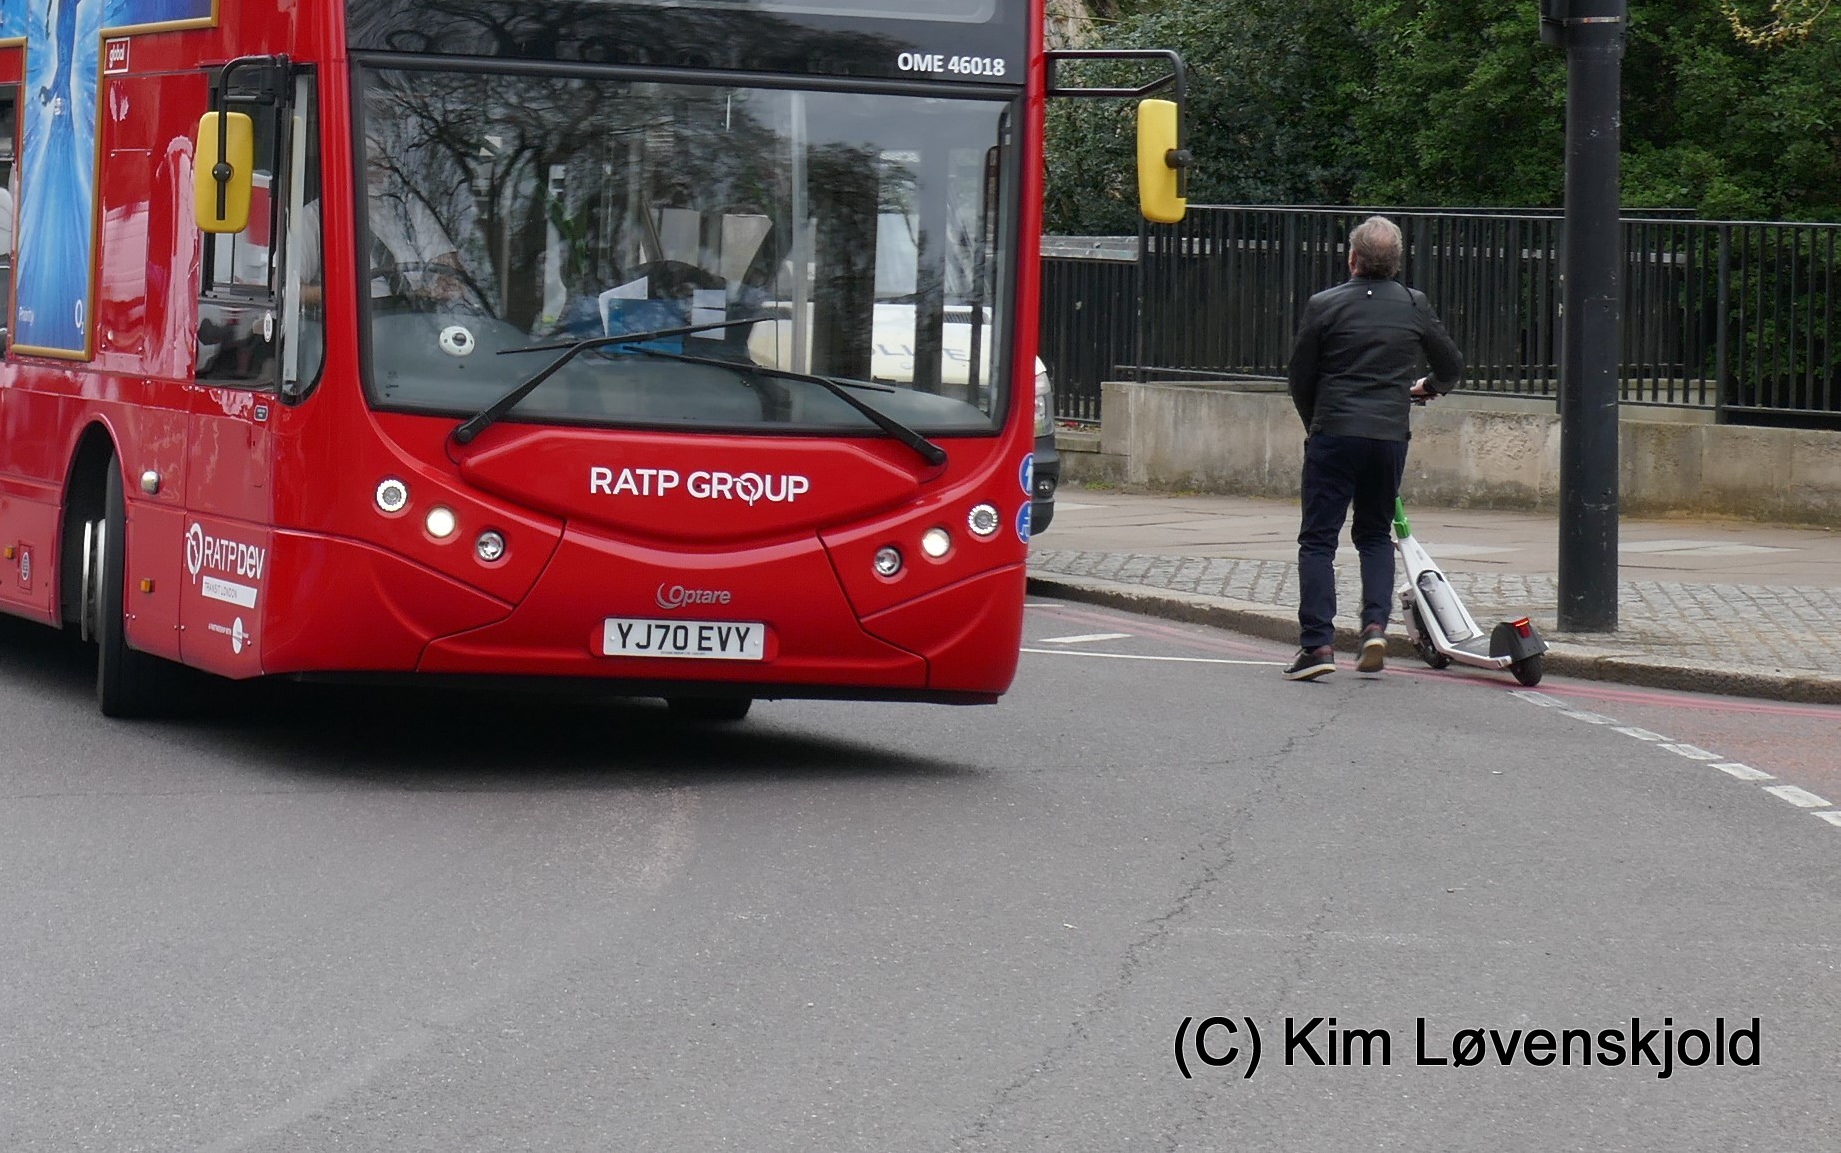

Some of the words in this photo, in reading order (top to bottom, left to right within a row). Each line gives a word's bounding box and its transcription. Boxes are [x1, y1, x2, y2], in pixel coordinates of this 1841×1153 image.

[109, 42, 125, 68] global
[897, 52, 944, 73] OME
[948, 54, 1006, 77] 46018
[590, 467, 680, 497] RATP
[687, 471, 809, 507] GROUP
[668, 585, 732, 607] Optare
[617, 623, 689, 651] YJ70
[697, 625, 751, 652] EVY
